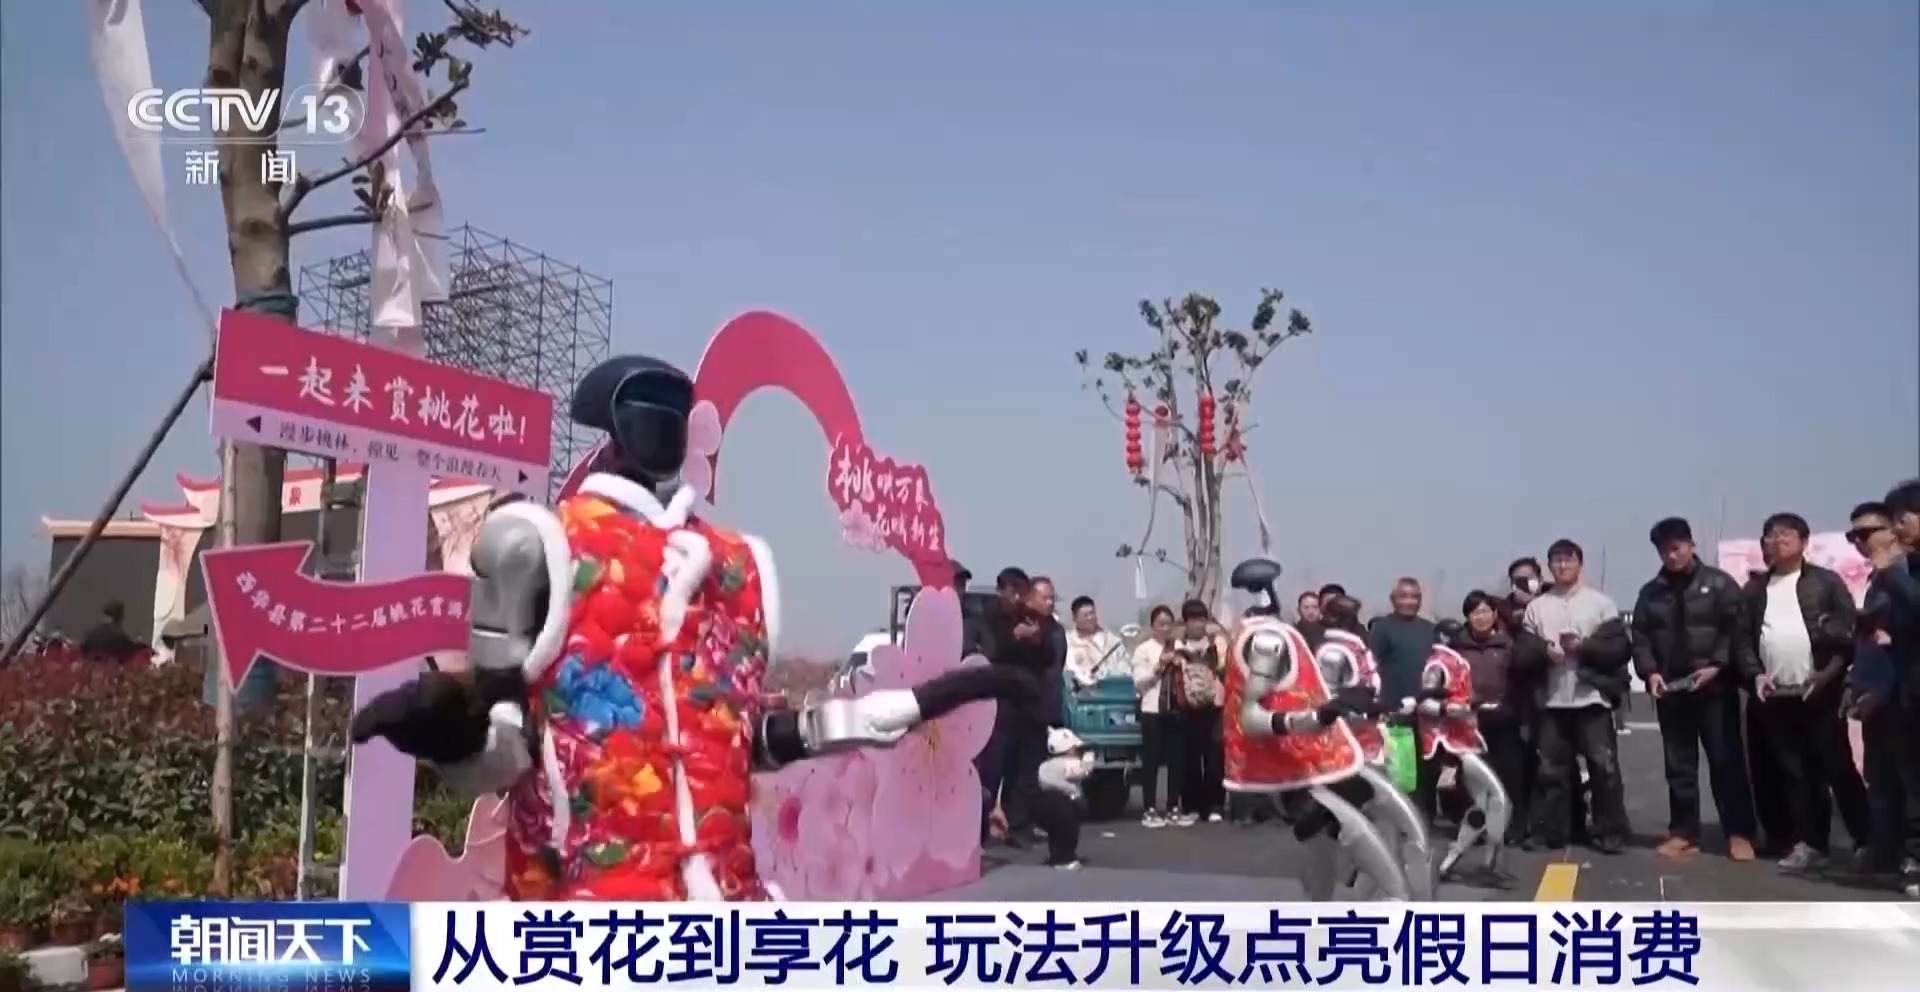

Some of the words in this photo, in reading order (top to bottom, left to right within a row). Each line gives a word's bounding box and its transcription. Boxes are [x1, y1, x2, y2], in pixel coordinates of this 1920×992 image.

[236, 571, 470, 634] 西华县第二十二届桃花赏游
